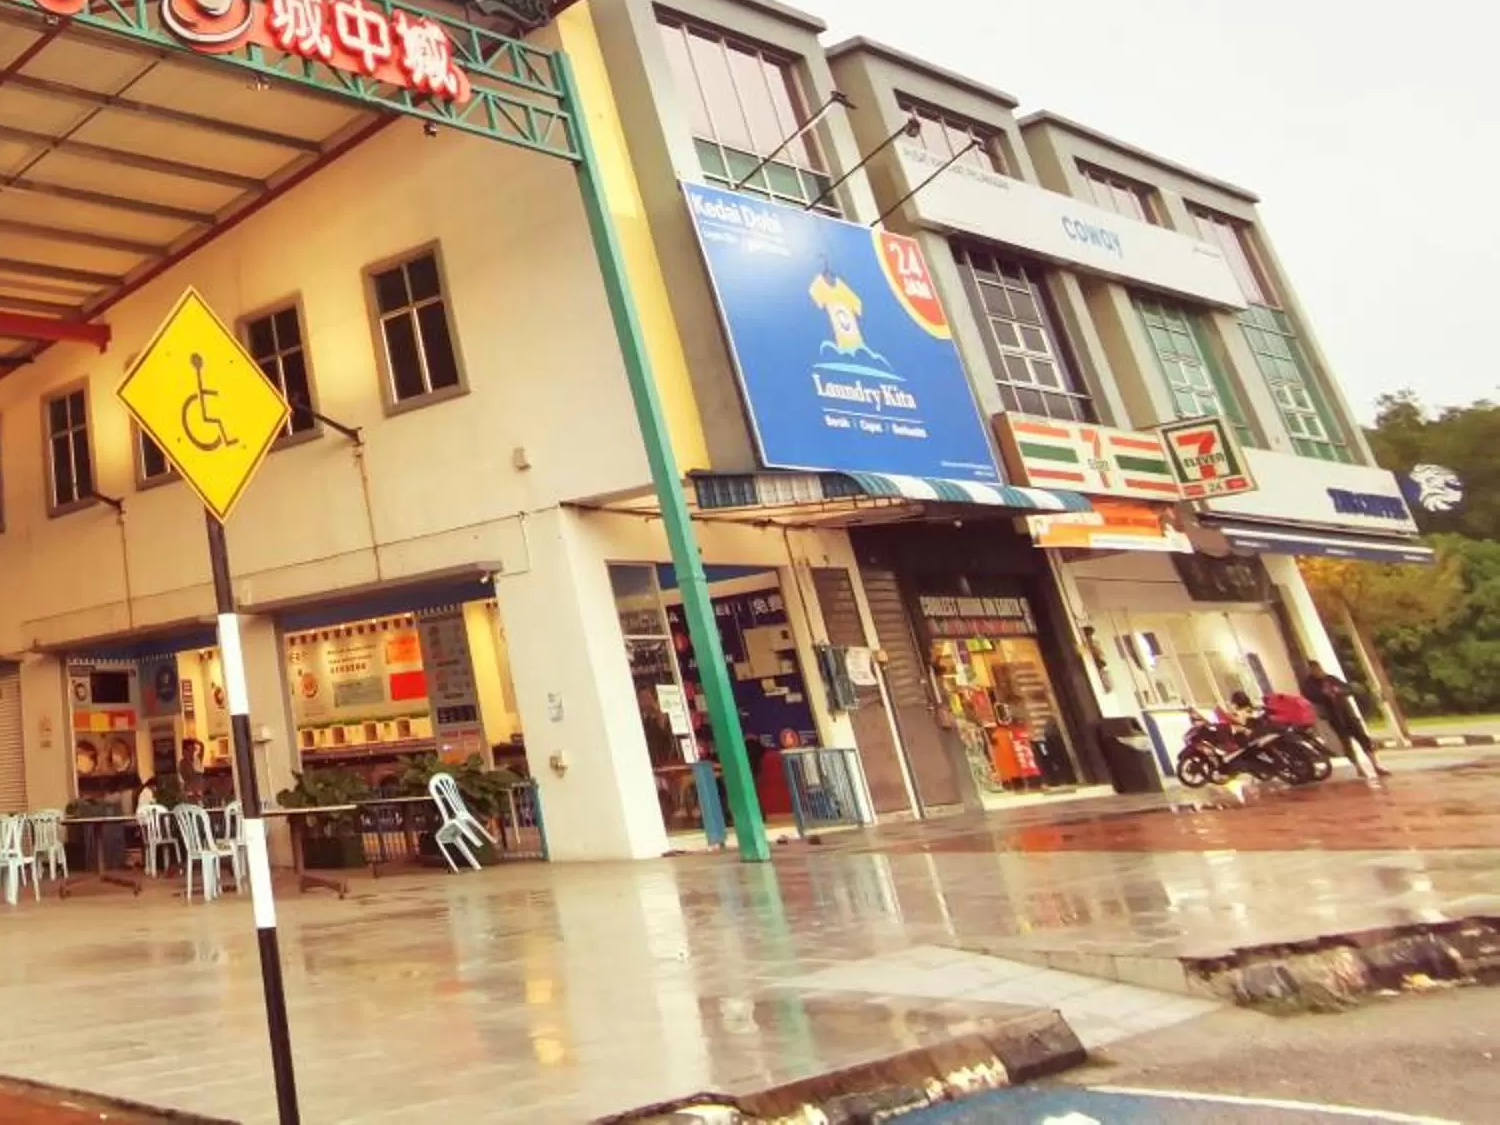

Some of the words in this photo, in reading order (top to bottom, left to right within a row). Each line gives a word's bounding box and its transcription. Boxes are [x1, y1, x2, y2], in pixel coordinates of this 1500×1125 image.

[887, 242, 923, 277] 24
[811, 373, 881, 412] Laundry
[879, 383, 917, 409] Kita
[1175, 430, 1217, 480] 7
